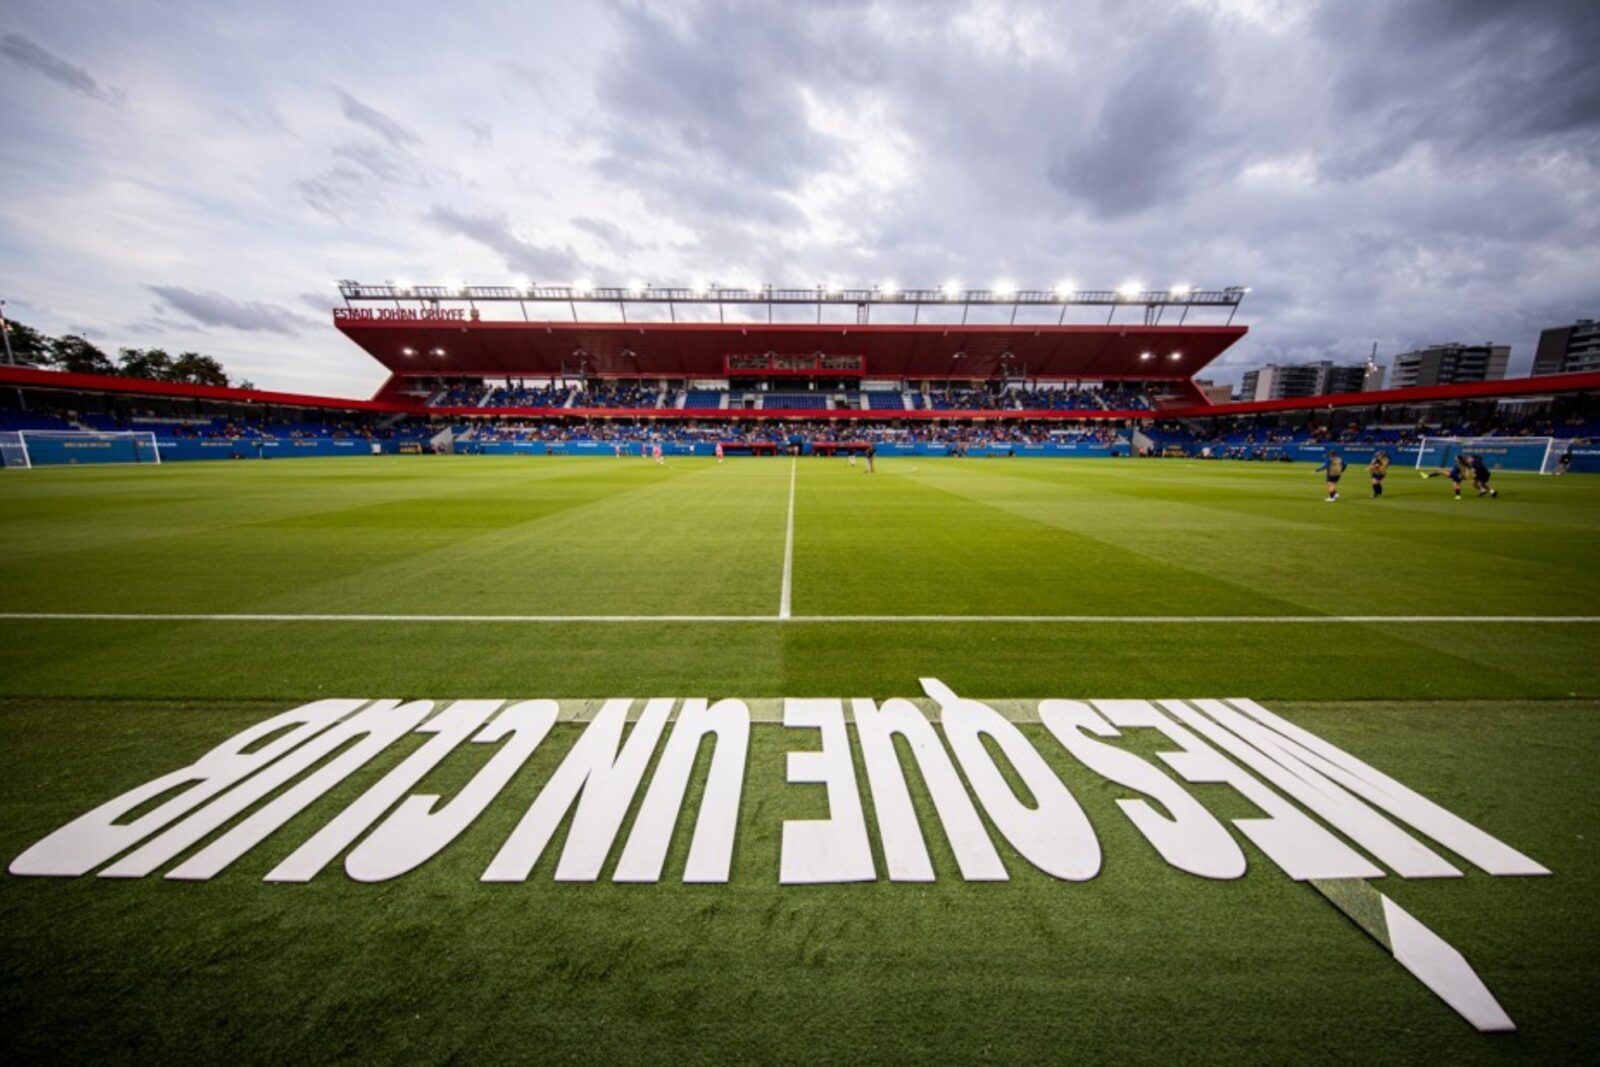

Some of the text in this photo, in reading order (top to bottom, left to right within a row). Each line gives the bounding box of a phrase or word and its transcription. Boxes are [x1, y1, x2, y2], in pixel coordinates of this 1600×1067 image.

[333, 308, 466, 320] ESTADI JOHAN CRUYFF
[8, 697, 560, 883] CLUB
[480, 697, 750, 883] UN
[779, 677, 1102, 883] QUE
